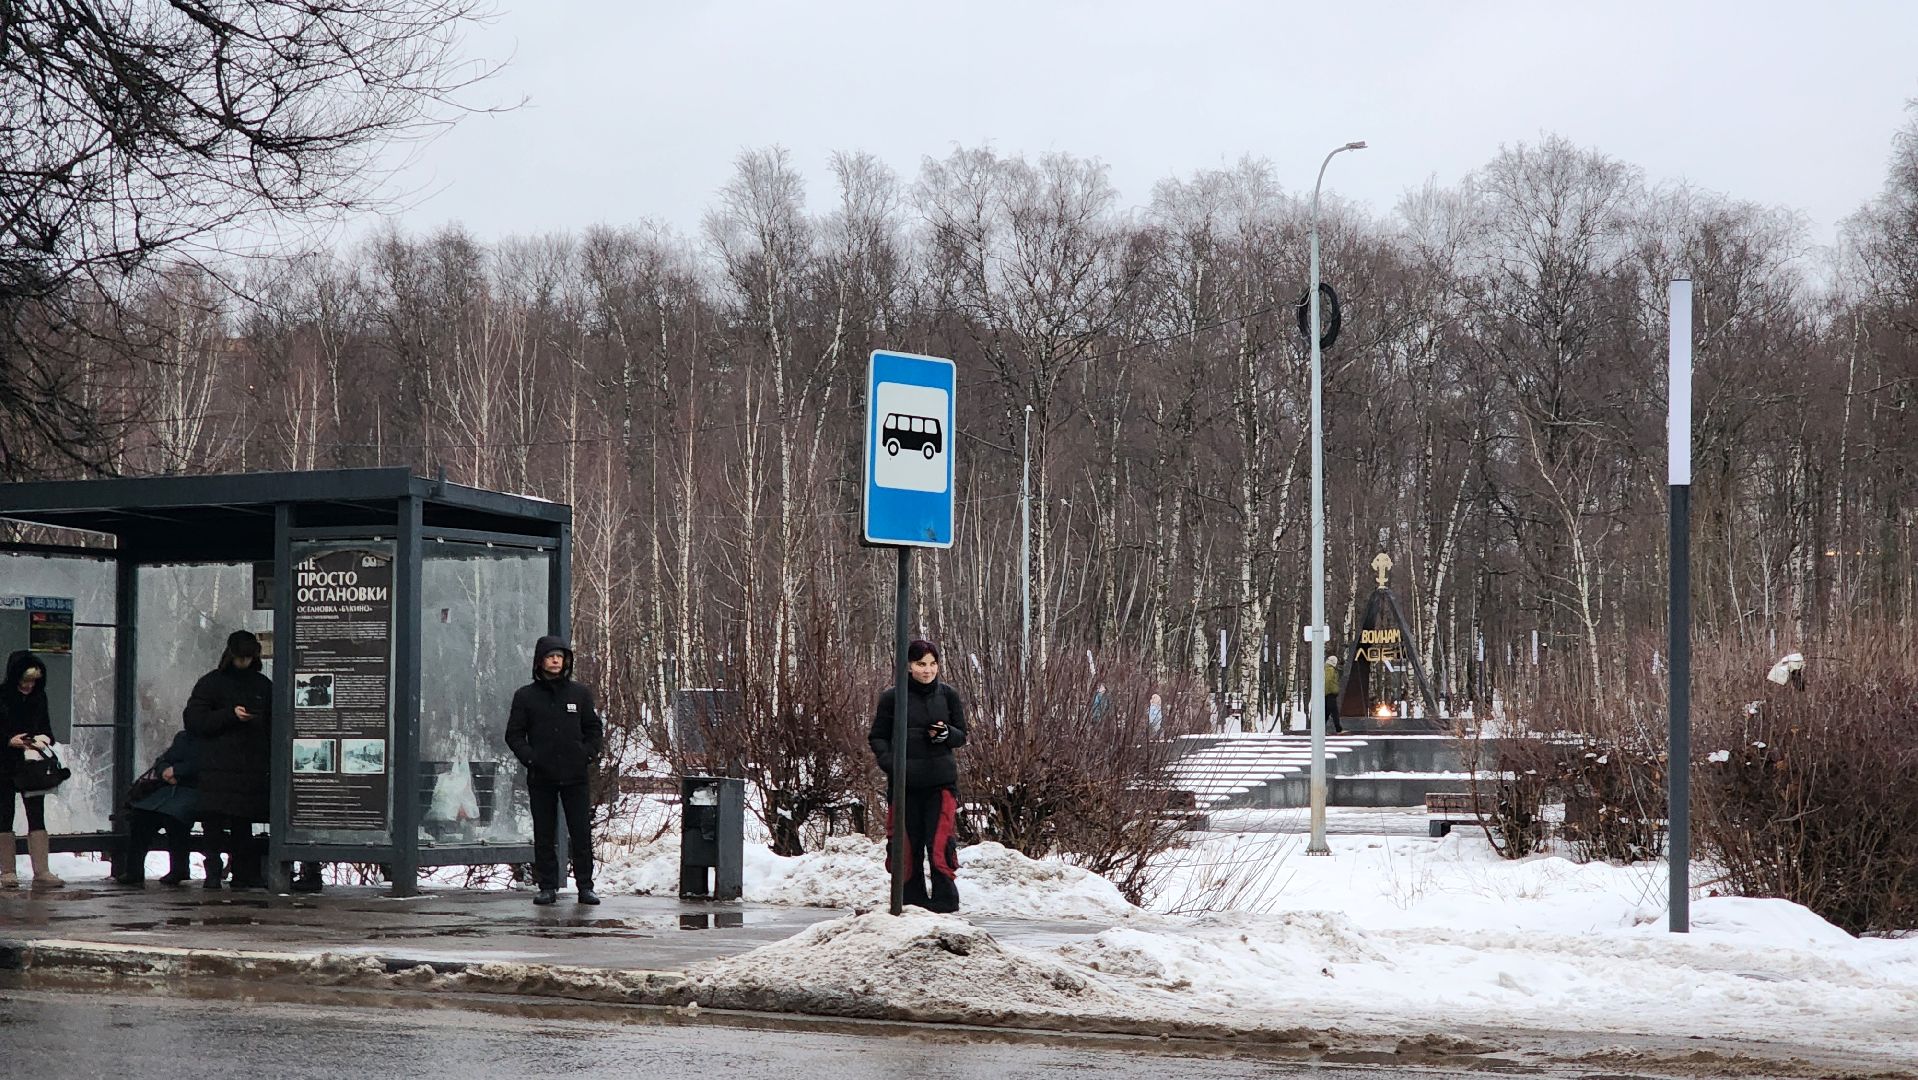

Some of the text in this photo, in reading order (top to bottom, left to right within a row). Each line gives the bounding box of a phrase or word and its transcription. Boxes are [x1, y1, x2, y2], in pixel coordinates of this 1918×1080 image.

[297, 571, 358, 586] ПРОСТО
[297, 587, 387, 602] ОСТАНОВКИ
[296, 605, 338, 613] ОСТАНОВКА
[1362, 629, 1401, 643] ВОИНАМ
